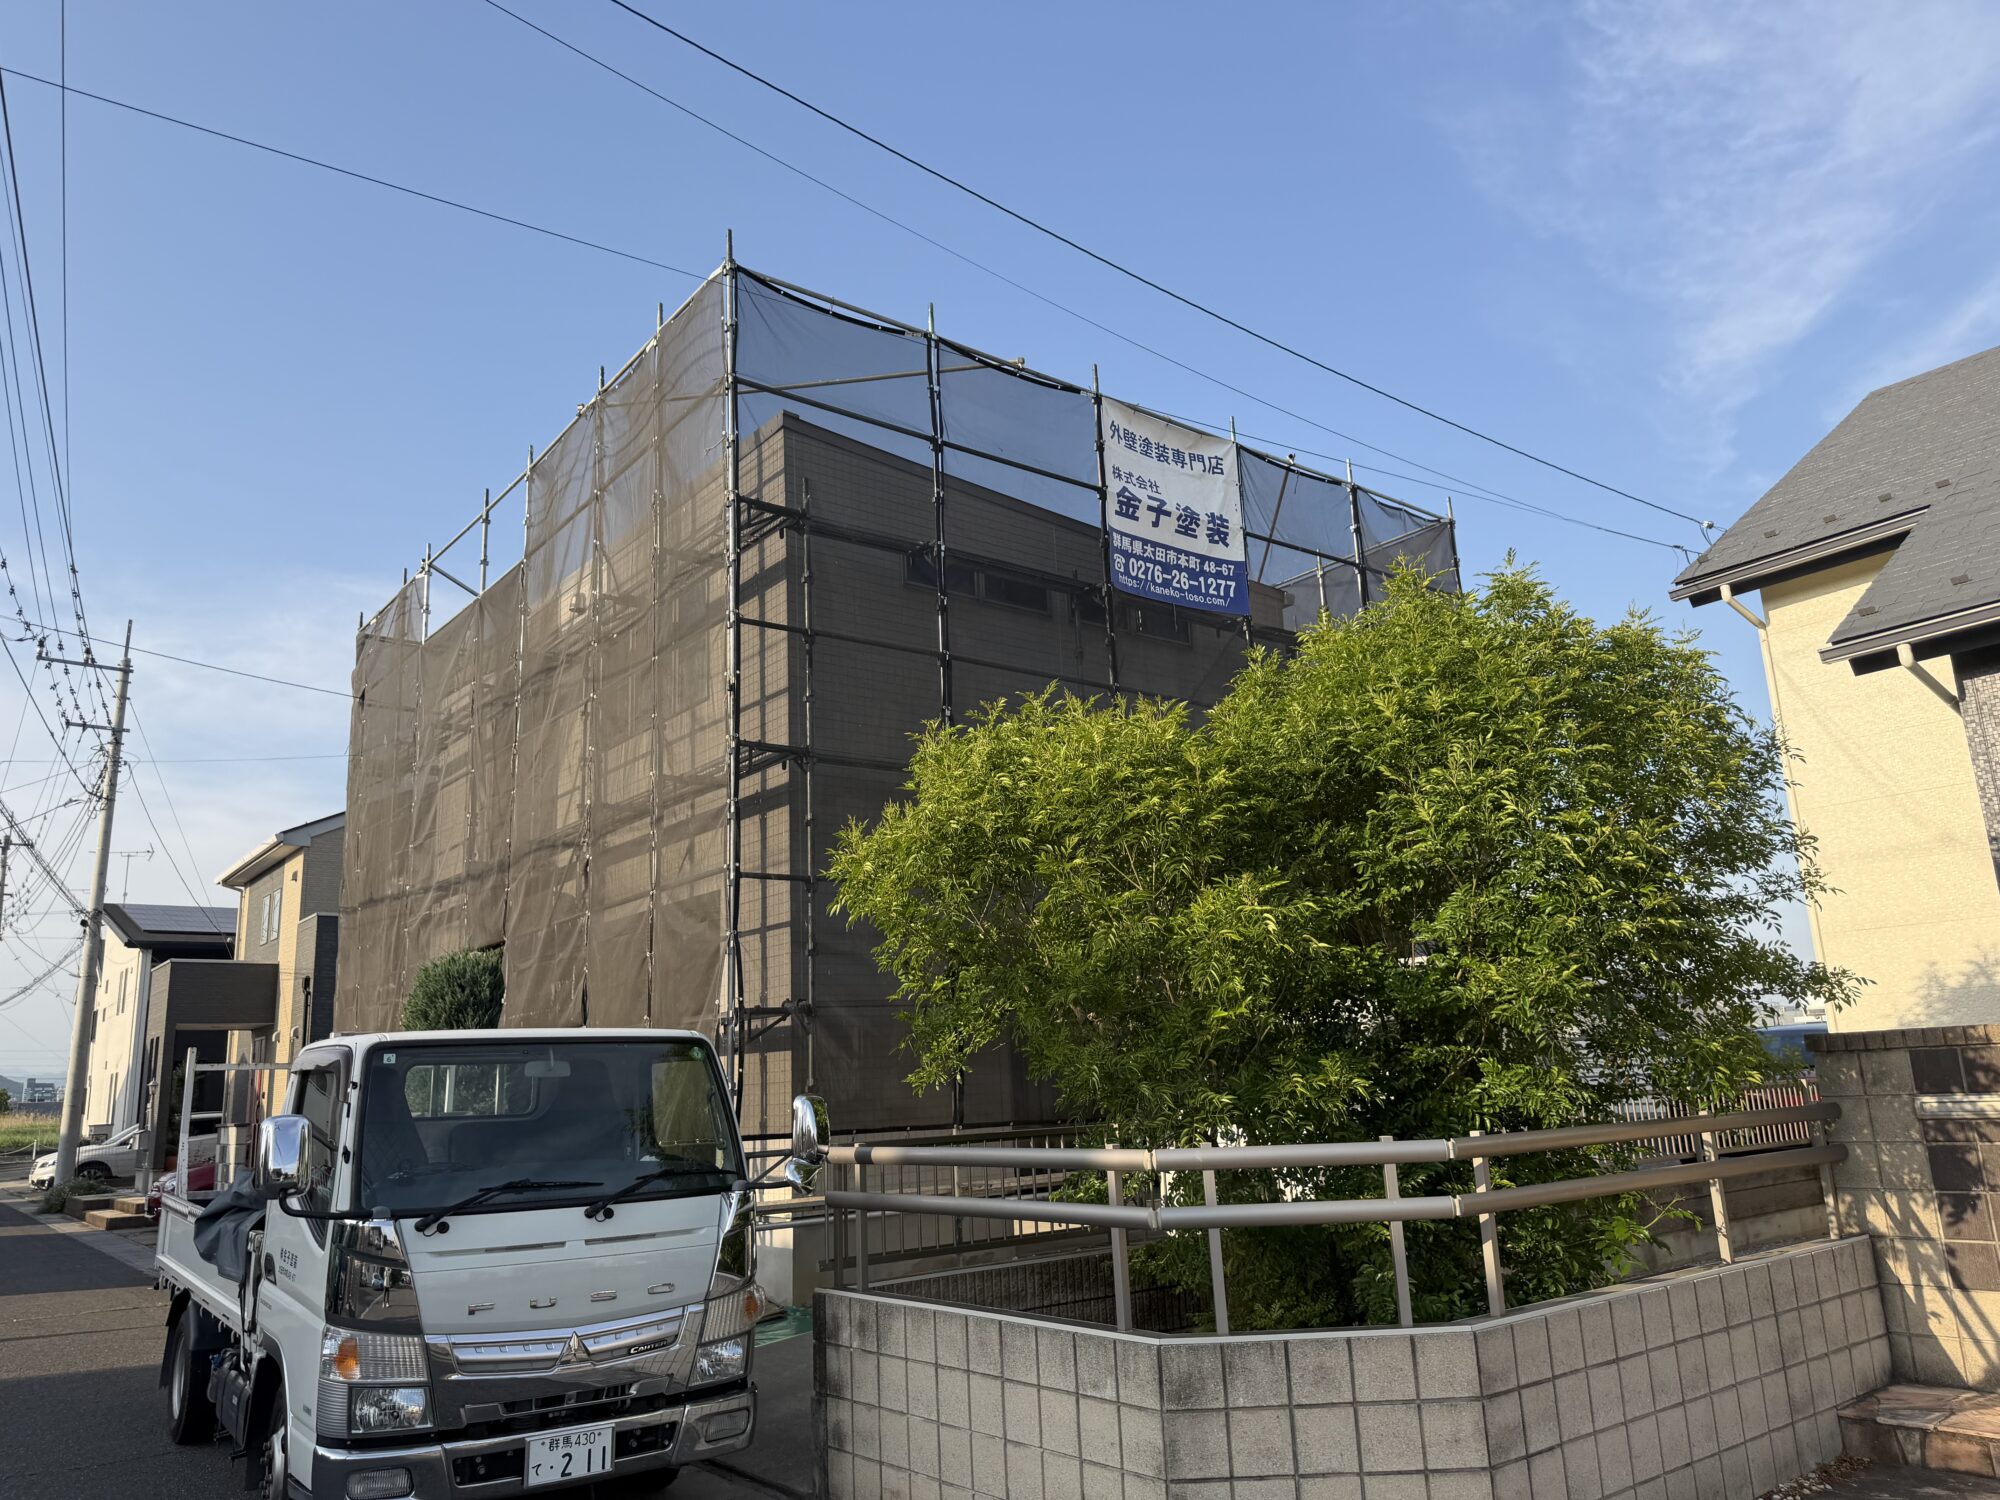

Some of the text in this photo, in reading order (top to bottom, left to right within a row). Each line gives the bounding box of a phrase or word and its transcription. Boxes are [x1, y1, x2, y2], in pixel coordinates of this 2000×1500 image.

[1109, 420, 1225, 476] 外壁塗装専門店
[1112, 464, 1162, 495] 株式会社
[1114, 485, 1231, 548] 金子塗装
[1112, 531, 1235, 577] 群馬県太田市本町 48-67
[1128, 557, 1237, 598] 0276-26-1277
[467, 1282, 675, 1316] FUSO
